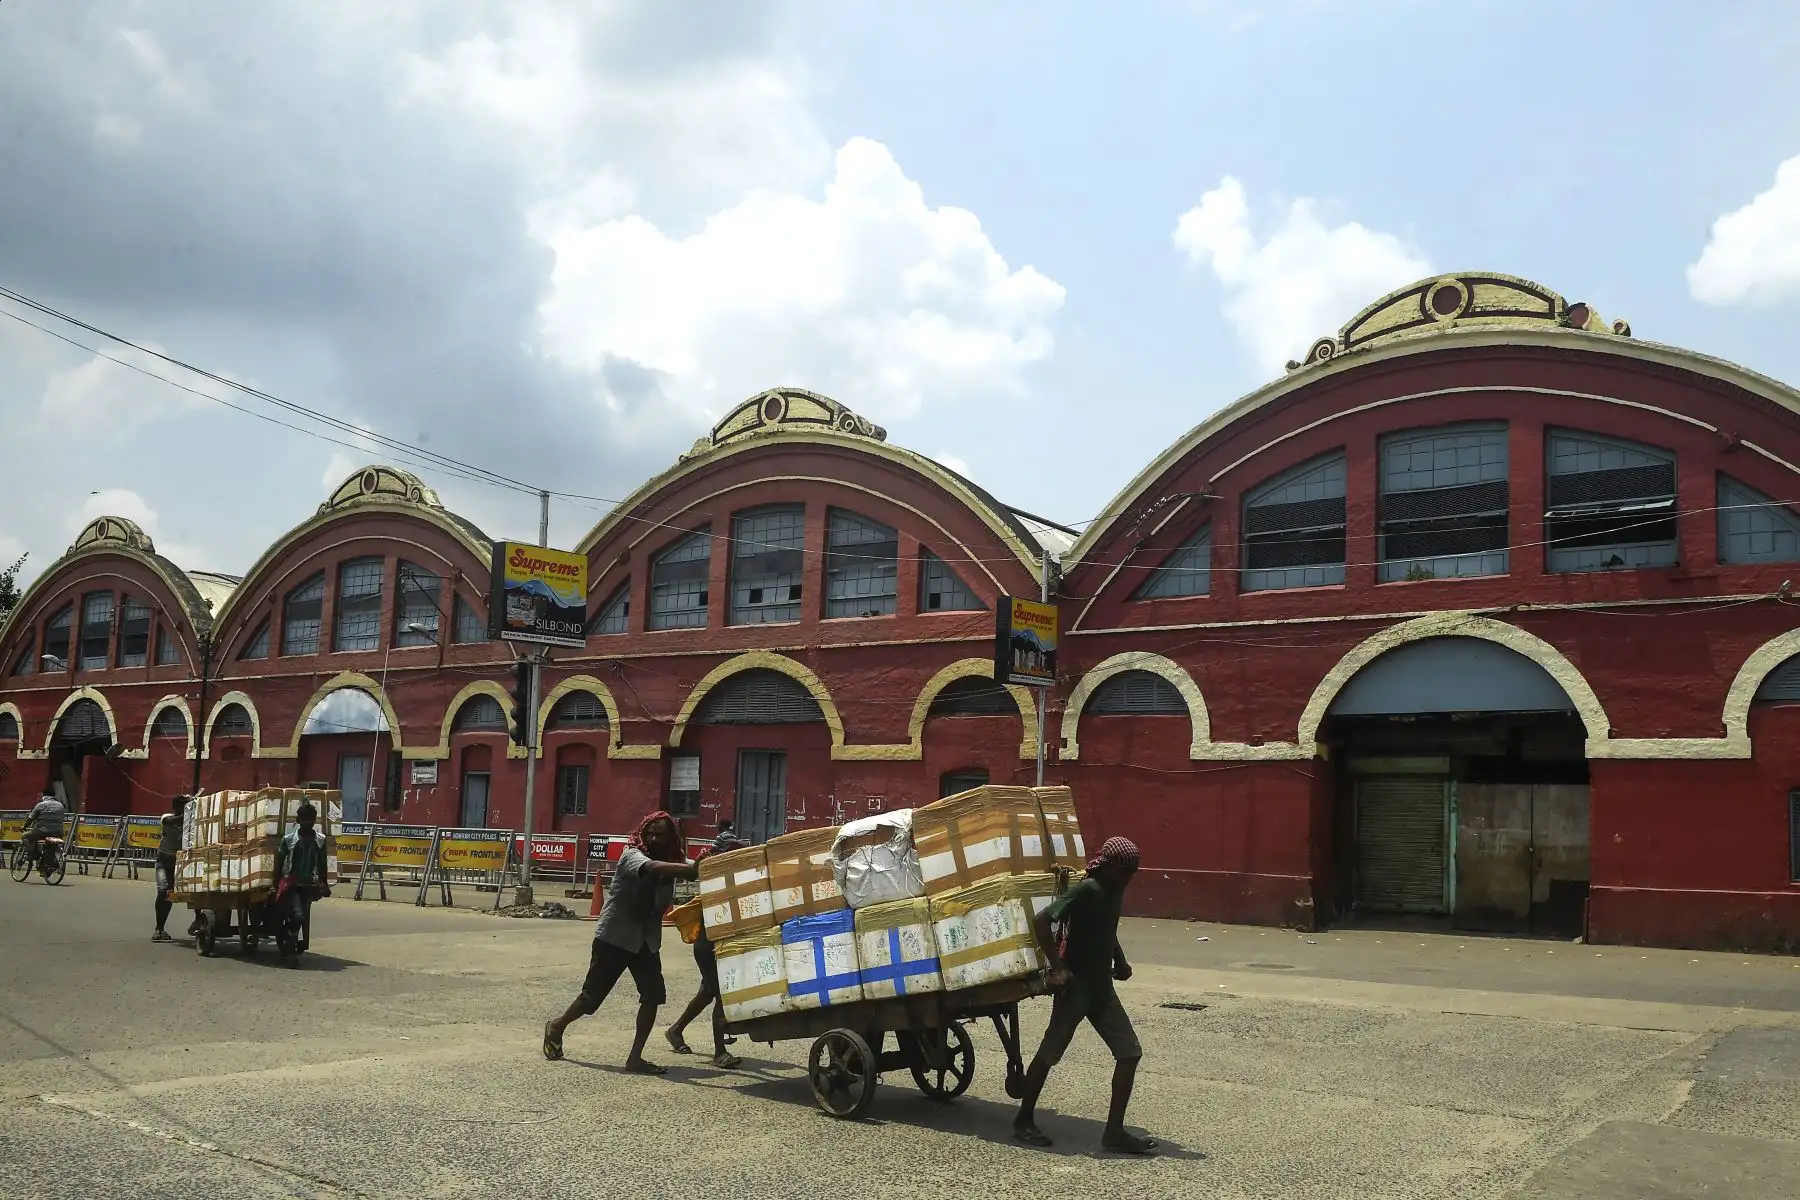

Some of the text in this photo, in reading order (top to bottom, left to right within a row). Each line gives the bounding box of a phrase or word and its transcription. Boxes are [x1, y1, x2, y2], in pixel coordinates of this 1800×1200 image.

[509, 548, 580, 576] Supreme
[1014, 602, 1054, 626] Supreme
[535, 618, 582, 634] SILBOND
[536, 844, 564, 854] DOLLAR
